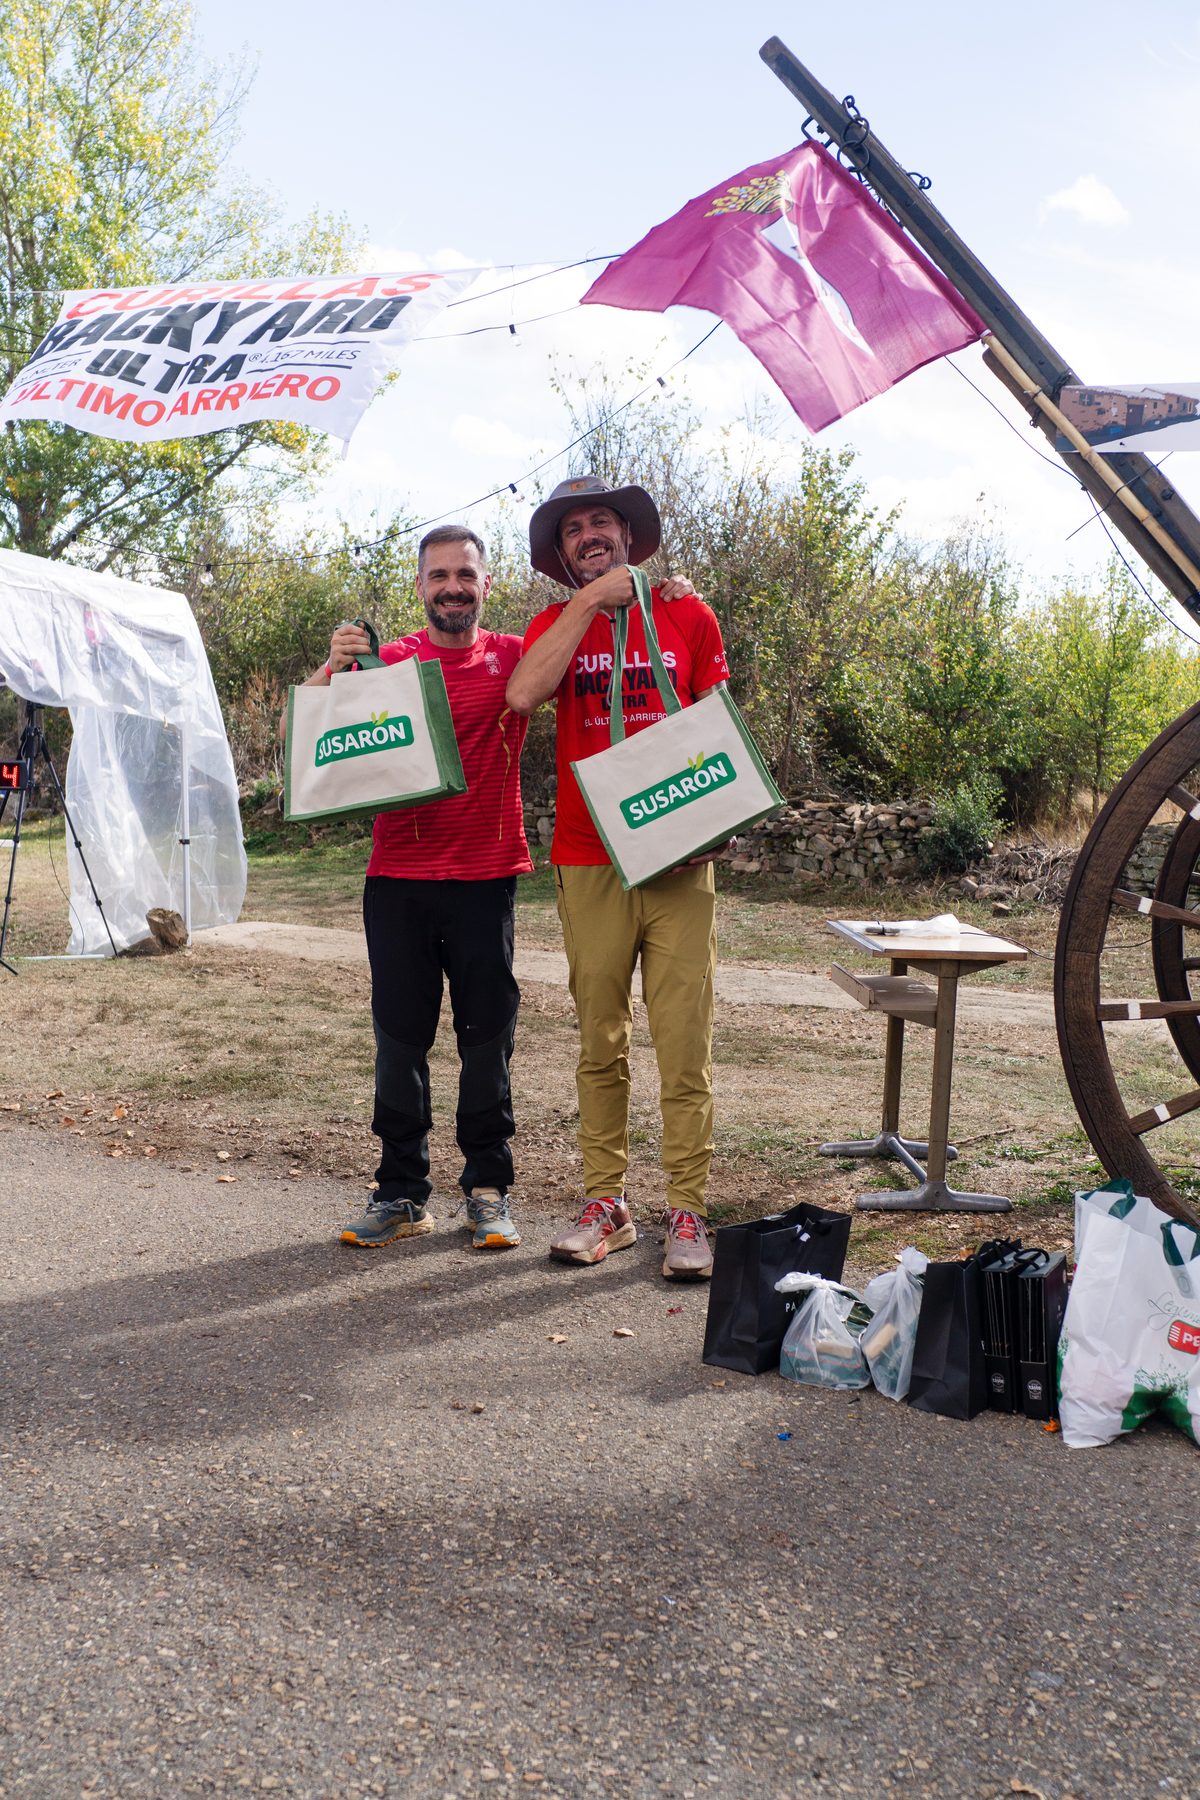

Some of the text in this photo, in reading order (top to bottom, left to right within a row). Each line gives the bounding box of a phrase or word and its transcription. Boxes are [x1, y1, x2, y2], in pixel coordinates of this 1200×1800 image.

[66, 273, 445, 320] CURILLAS
[26, 296, 413, 367] BACKYARD
[303, 349, 361, 360] MILES
[166, 373, 341, 422] ARRIERO
[575, 650, 677, 674] CURLLS
[575, 667, 678, 698] BACYAD
[601, 693, 648, 711] UTRA
[585, 712, 669, 728] EL ÚLTO ARRIERO
[3, 764, 18, 788] 4
